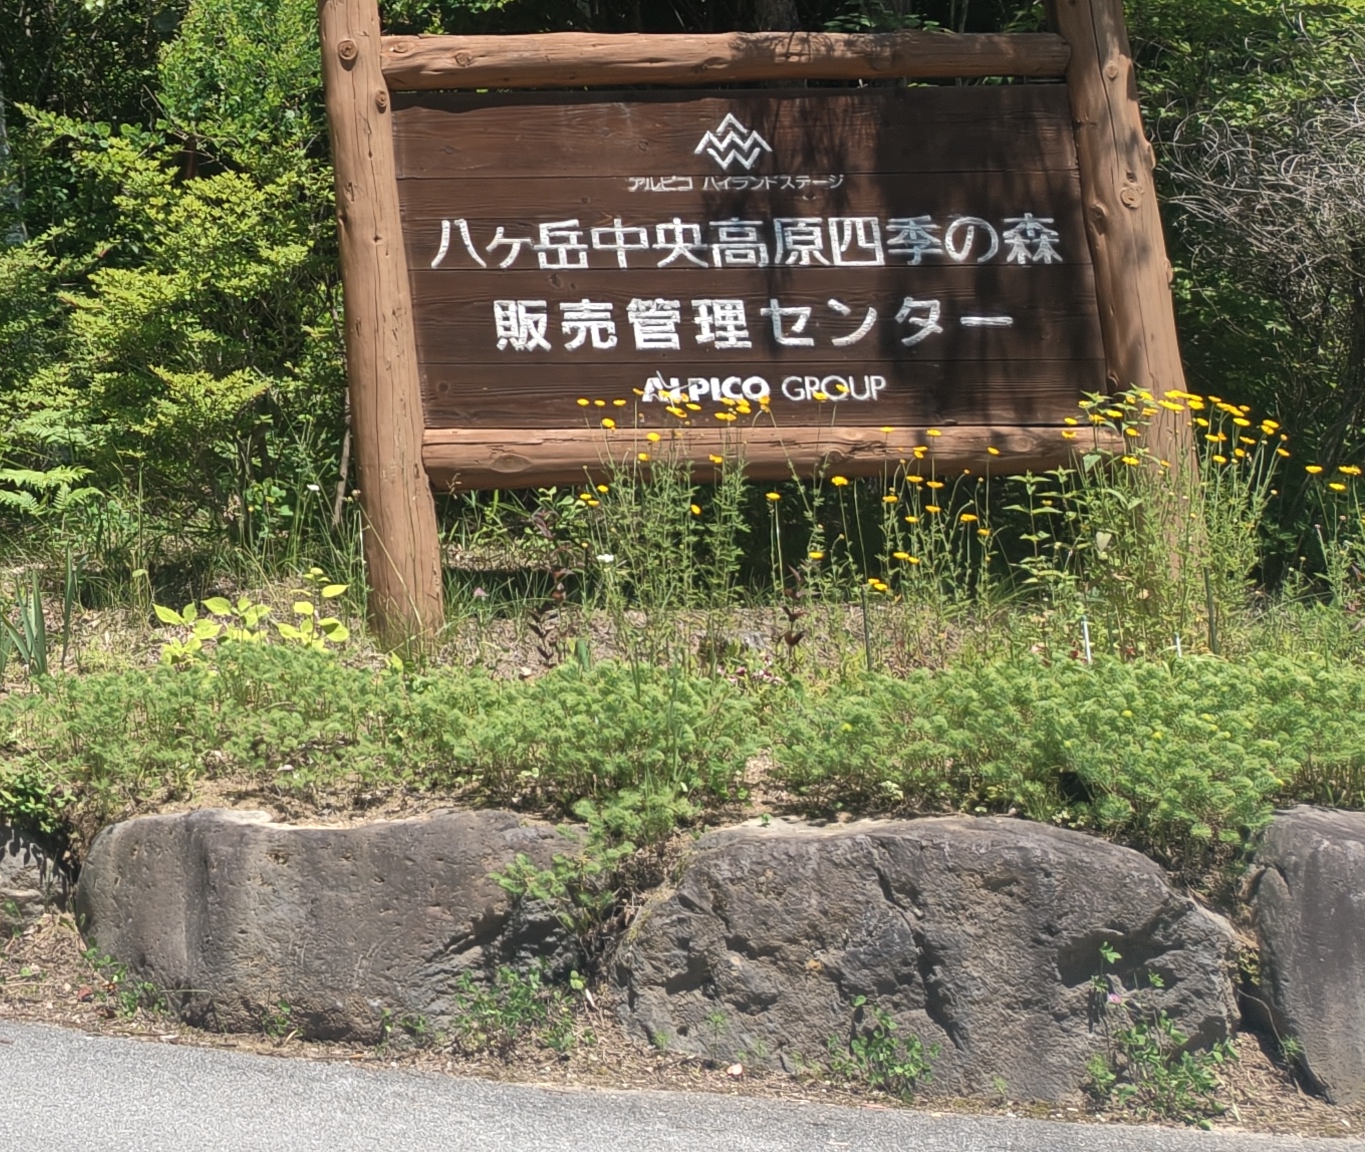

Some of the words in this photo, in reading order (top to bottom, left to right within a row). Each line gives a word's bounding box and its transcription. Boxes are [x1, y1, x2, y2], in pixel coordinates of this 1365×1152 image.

[702, 174, 844, 191] ハイランドステージ
[430, 212, 1064, 270] 八ヶ岳中央高原四季の森
[493, 297, 1014, 352] 販売管理センター
[781, 375, 887, 401] GROUP
